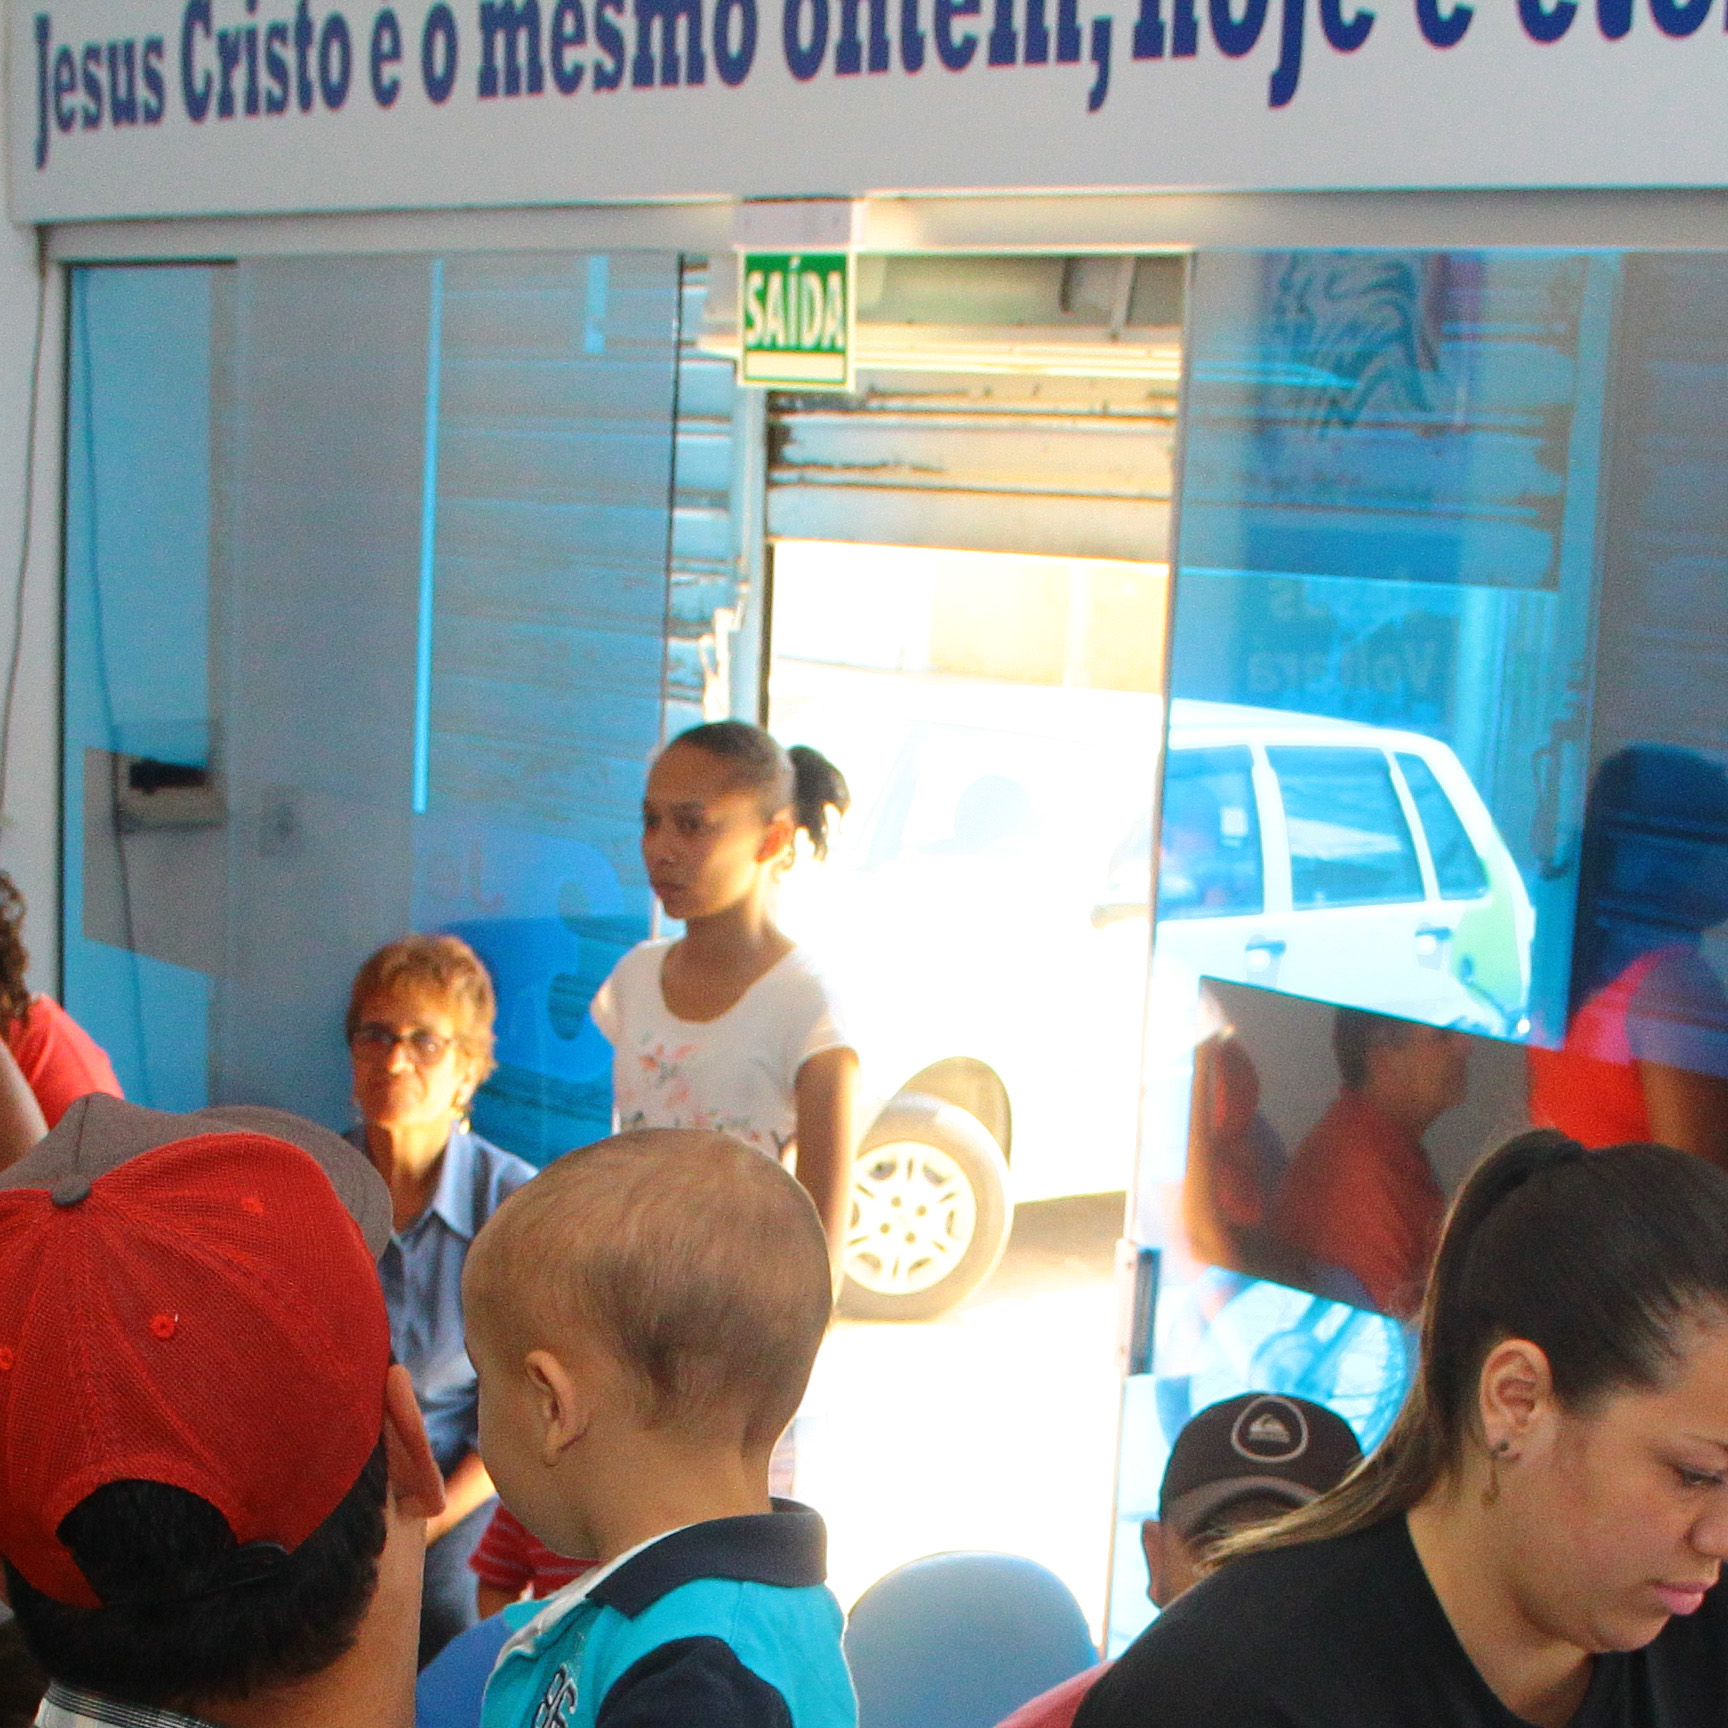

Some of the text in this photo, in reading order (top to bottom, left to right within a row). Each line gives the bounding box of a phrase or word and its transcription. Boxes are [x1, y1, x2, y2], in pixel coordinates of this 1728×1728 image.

[34, 12, 165, 170] Jesus
[181, 0, 351, 123] Cristo
[370, 7, 402, 109] e
[421, 1, 458, 106] o
[476, 0, 758, 101] mesmo
[745, 255, 845, 348] SAÍDA
